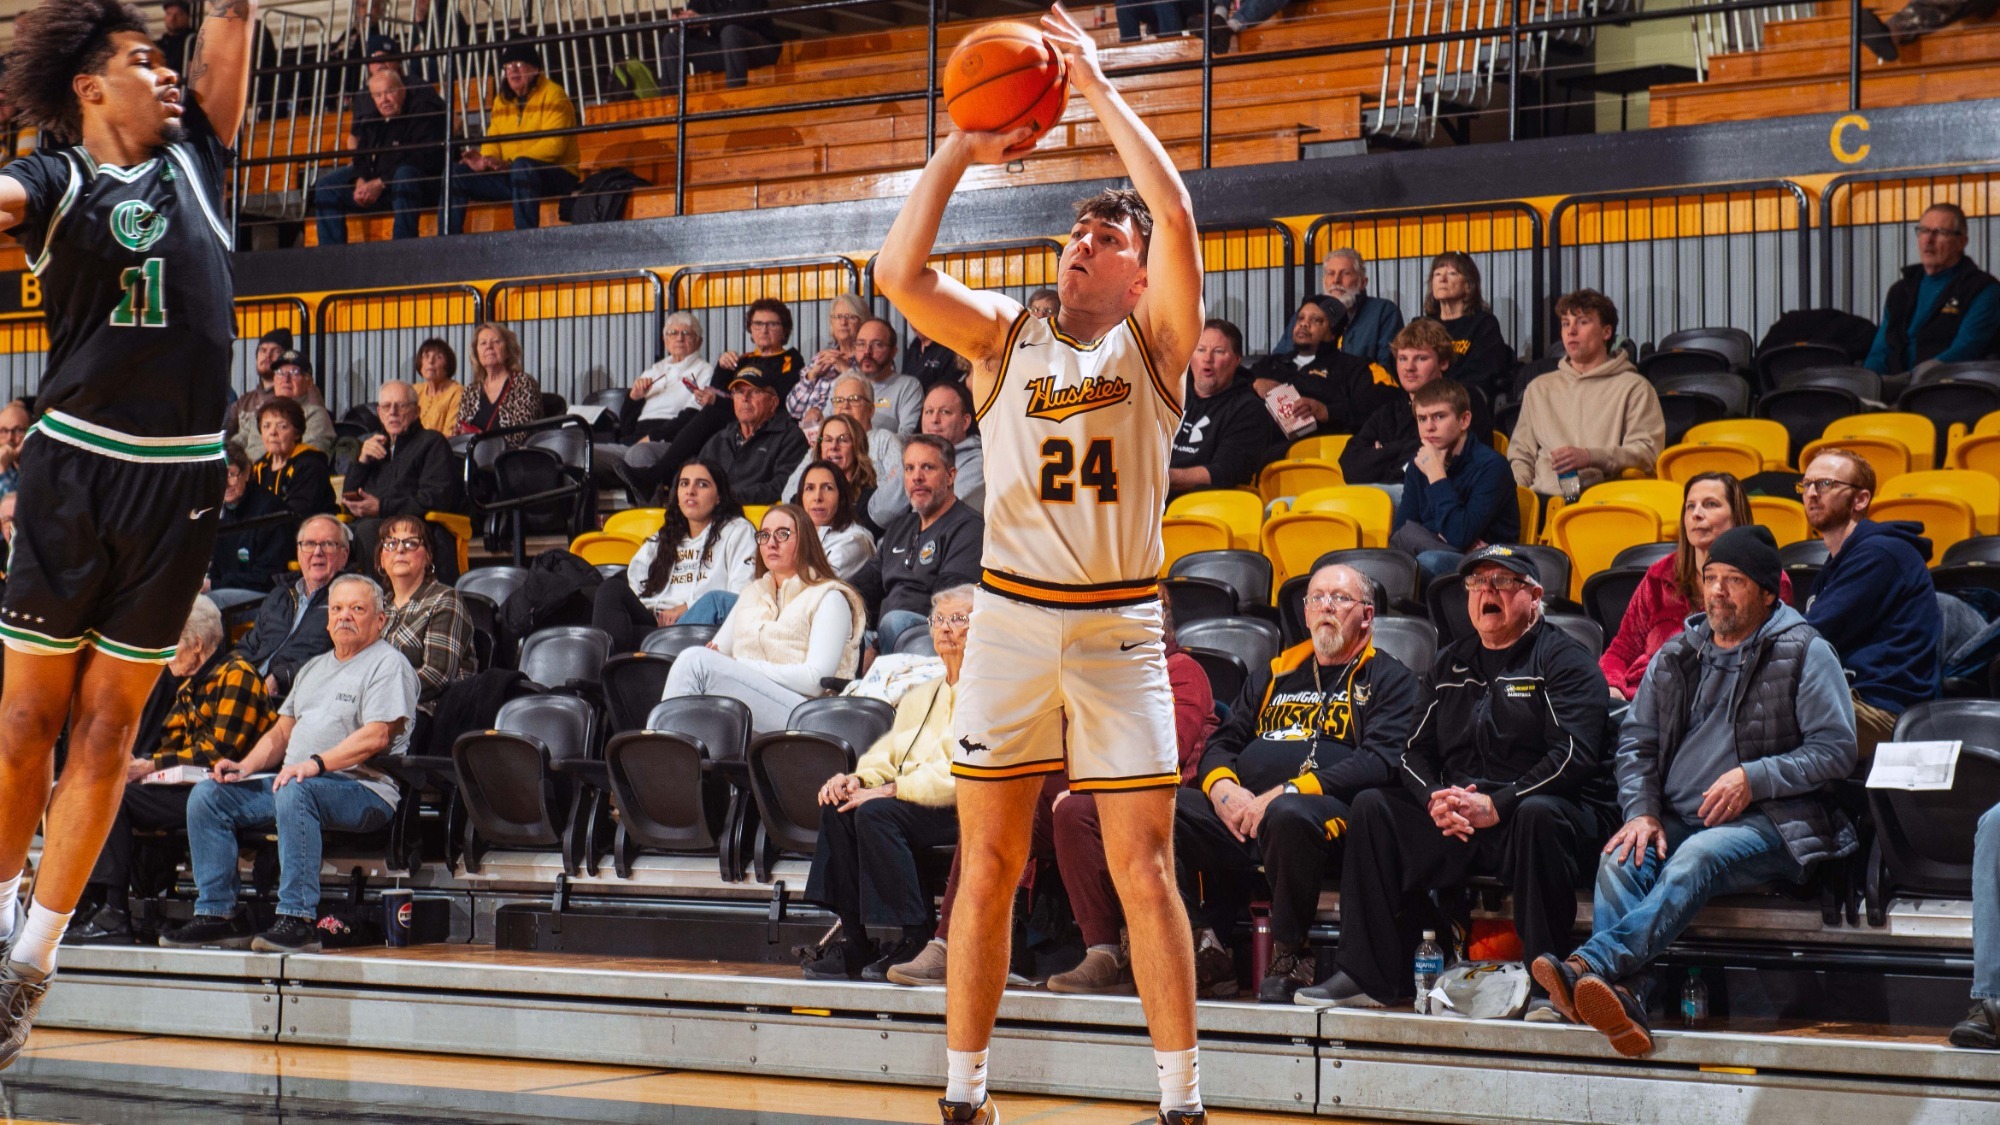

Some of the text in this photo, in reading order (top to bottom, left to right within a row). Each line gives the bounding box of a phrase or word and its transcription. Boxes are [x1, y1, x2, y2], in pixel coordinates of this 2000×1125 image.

[1830, 114, 1870, 164] C
[22, 272, 42, 308] B
[1024, 375, 1132, 419] Huskies
[1038, 436, 1120, 505] 24
